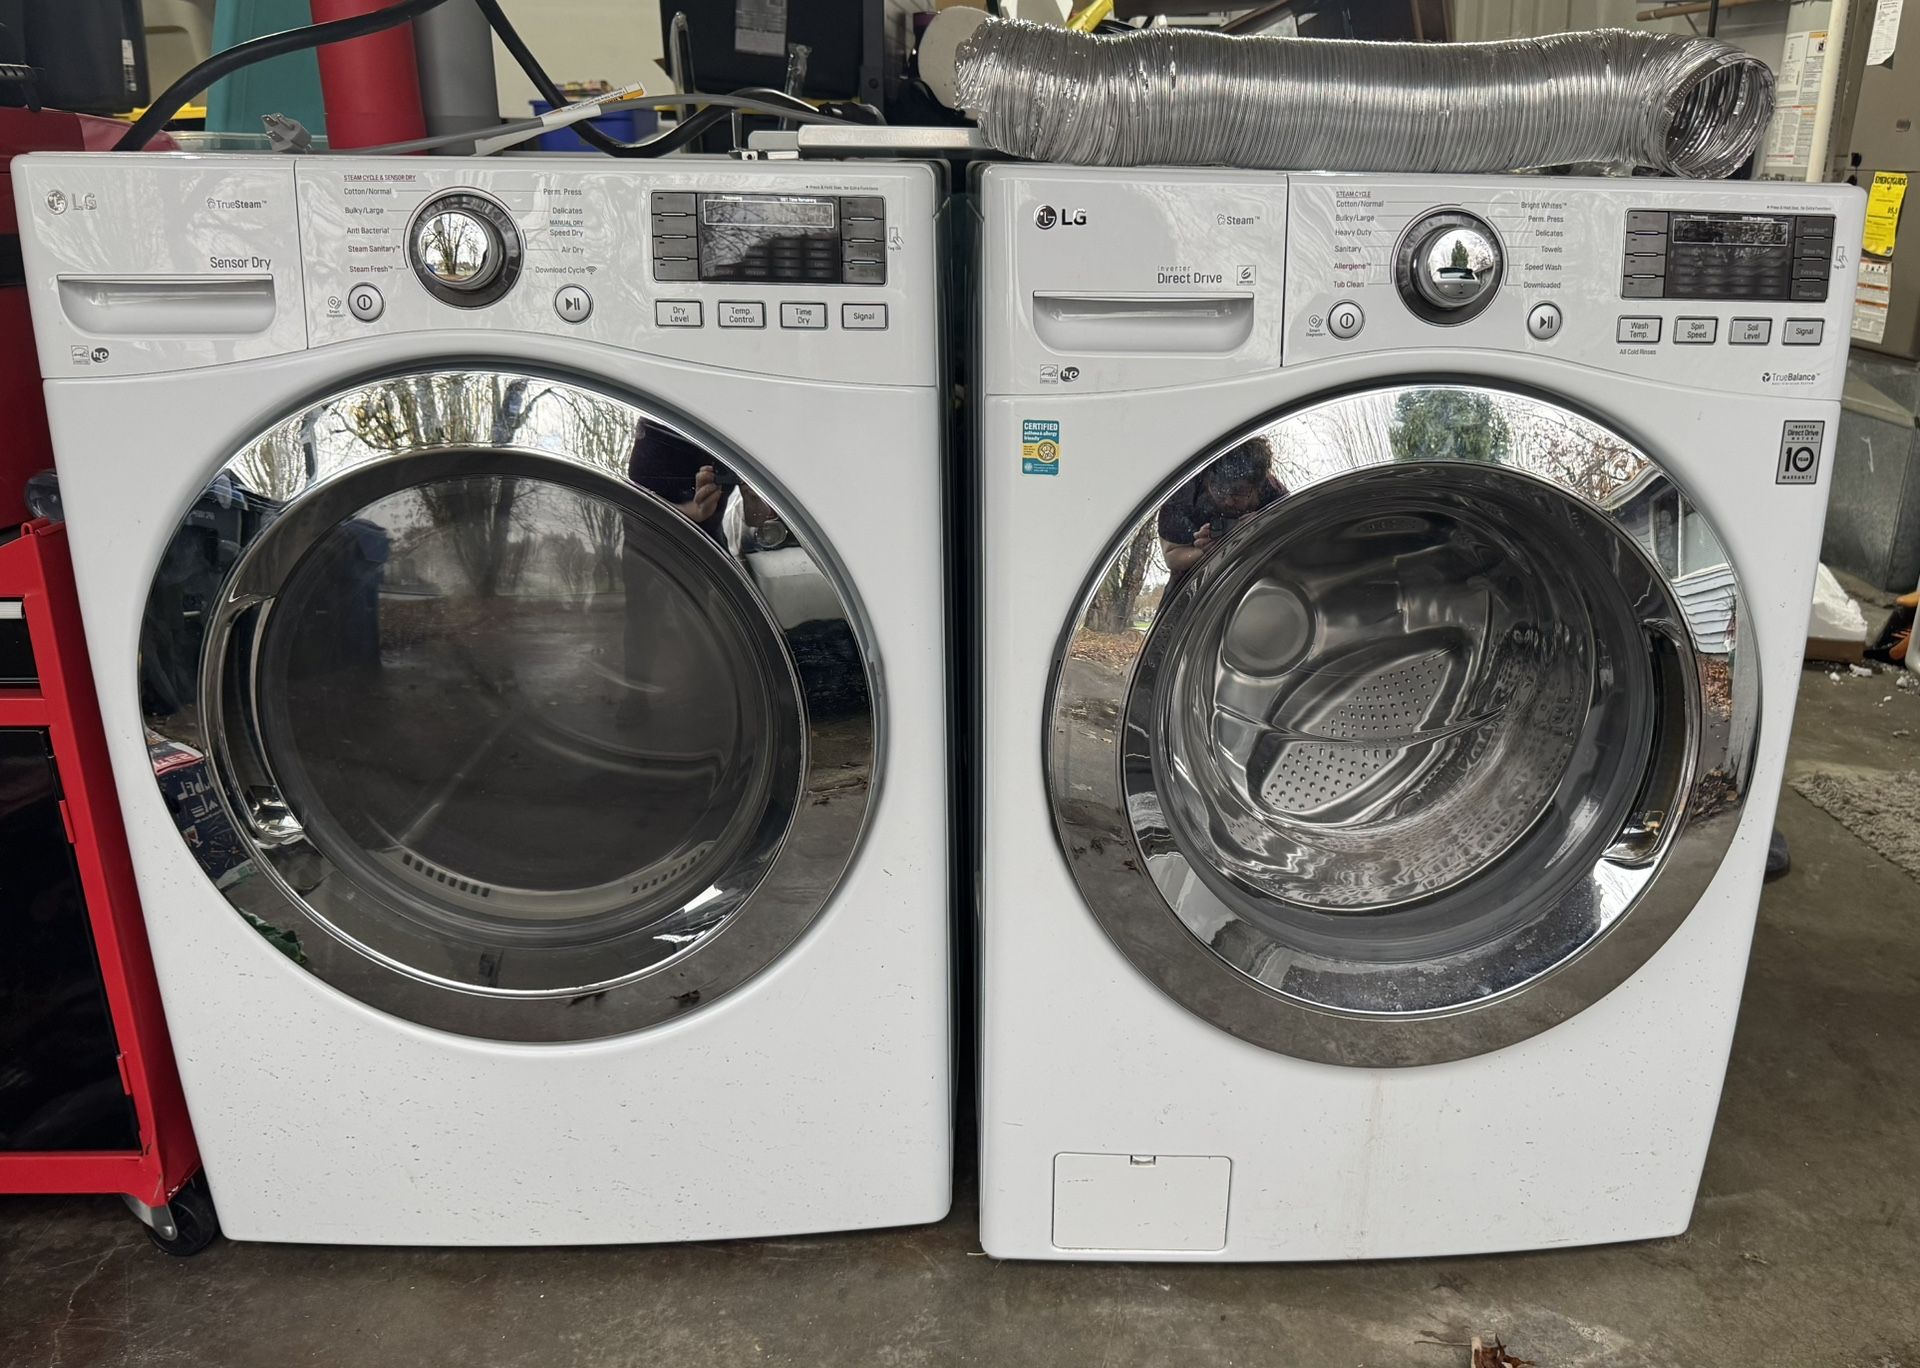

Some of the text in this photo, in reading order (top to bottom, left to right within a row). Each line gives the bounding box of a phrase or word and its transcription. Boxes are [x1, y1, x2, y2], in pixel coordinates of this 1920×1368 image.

[344, 188, 392, 196] Cotton/Normal
[564, 188, 582, 196] Press
[72, 193, 98, 210] LG
[1336, 200, 1384, 208] Cotton/Normal
[1521, 202, 1540, 210] Bright
[345, 207, 384, 215] Bulky/Large
[1061, 208, 1087, 226] LG
[1335, 229, 1355, 237] Heavy
[210, 256, 271, 270] Sensor Dry
[568, 266, 585, 275] Cycle
[1157, 273, 1222, 284] Direct Drive
[673, 306, 685, 315] Dry
[795, 308, 812, 316] Time
[670, 315, 689, 323] Level
[729, 315, 755, 323] Control
[798, 316, 810, 324] Dry
[854, 312, 874, 321] Signal
[1630, 331, 1648, 339] Temp.
[1687, 331, 1707, 339] Speed
[1744, 332, 1760, 340] Level
[1796, 328, 1814, 336] Signal
[1024, 423, 1058, 431] CERTIFIED
[1785, 447, 1814, 472] 10
